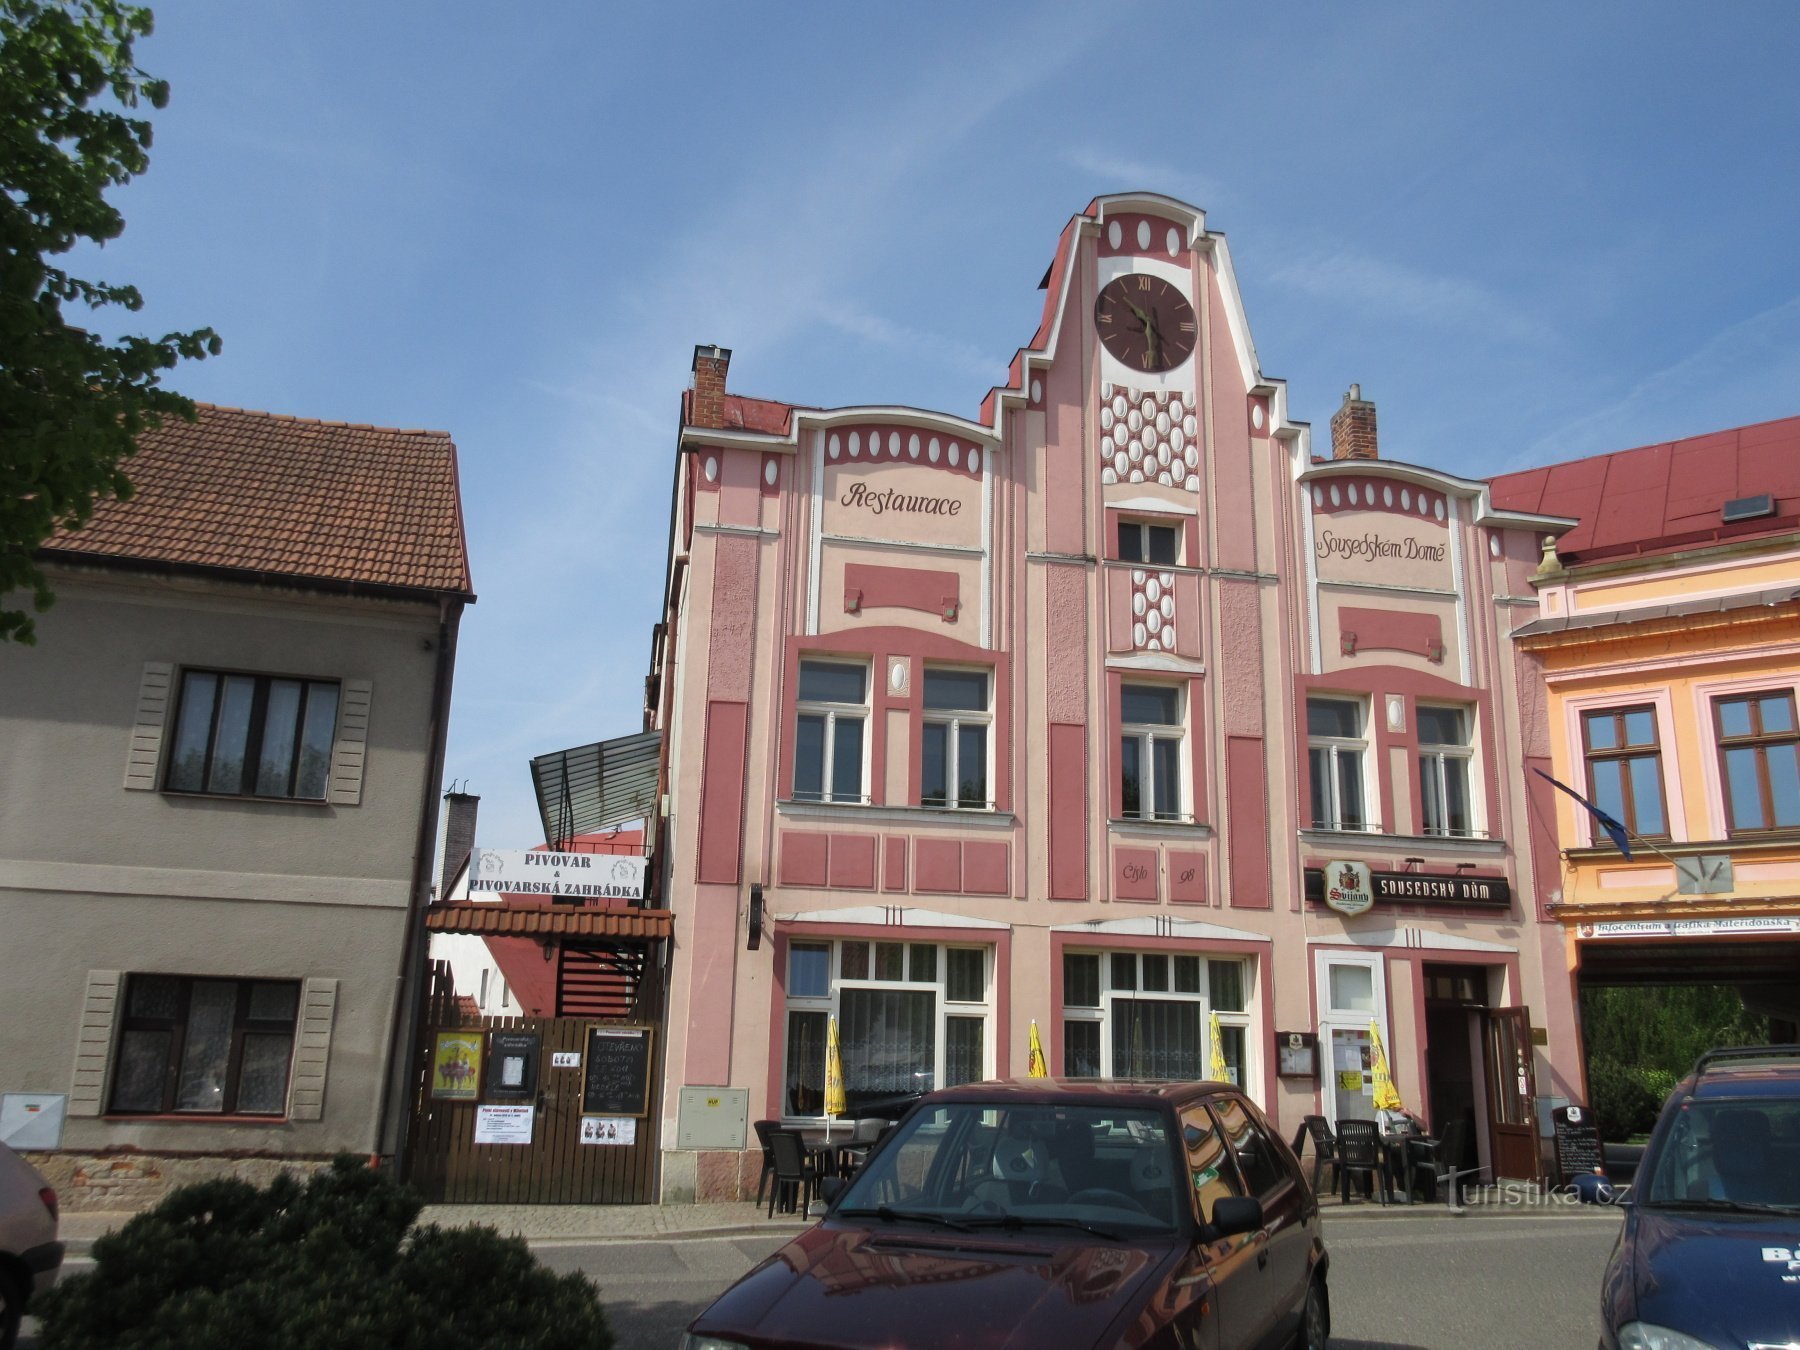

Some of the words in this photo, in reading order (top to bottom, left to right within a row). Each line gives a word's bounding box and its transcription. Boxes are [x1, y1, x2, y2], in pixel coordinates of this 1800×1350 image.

[1138, 276, 1151, 291] XII
[841, 482, 962, 516] Restaurace
[1318, 530, 1402, 562] Sousedském
[1404, 537, 1447, 562] Domě
[524, 853, 591, 869] PIVOVAR
[553, 870, 561, 878] &
[1177, 868, 1195, 884] 98
[469, 880, 560, 894] PIVOVARSKÁ
[564, 883, 641, 898] ZAHRÁDKA
[1329, 887, 1369, 901] Svijany
[1381, 880, 1456, 898] SOUSEDSKÝ
[1462, 881, 1490, 899] DŮM
[1597, 923, 1661, 932] Infocentrum
